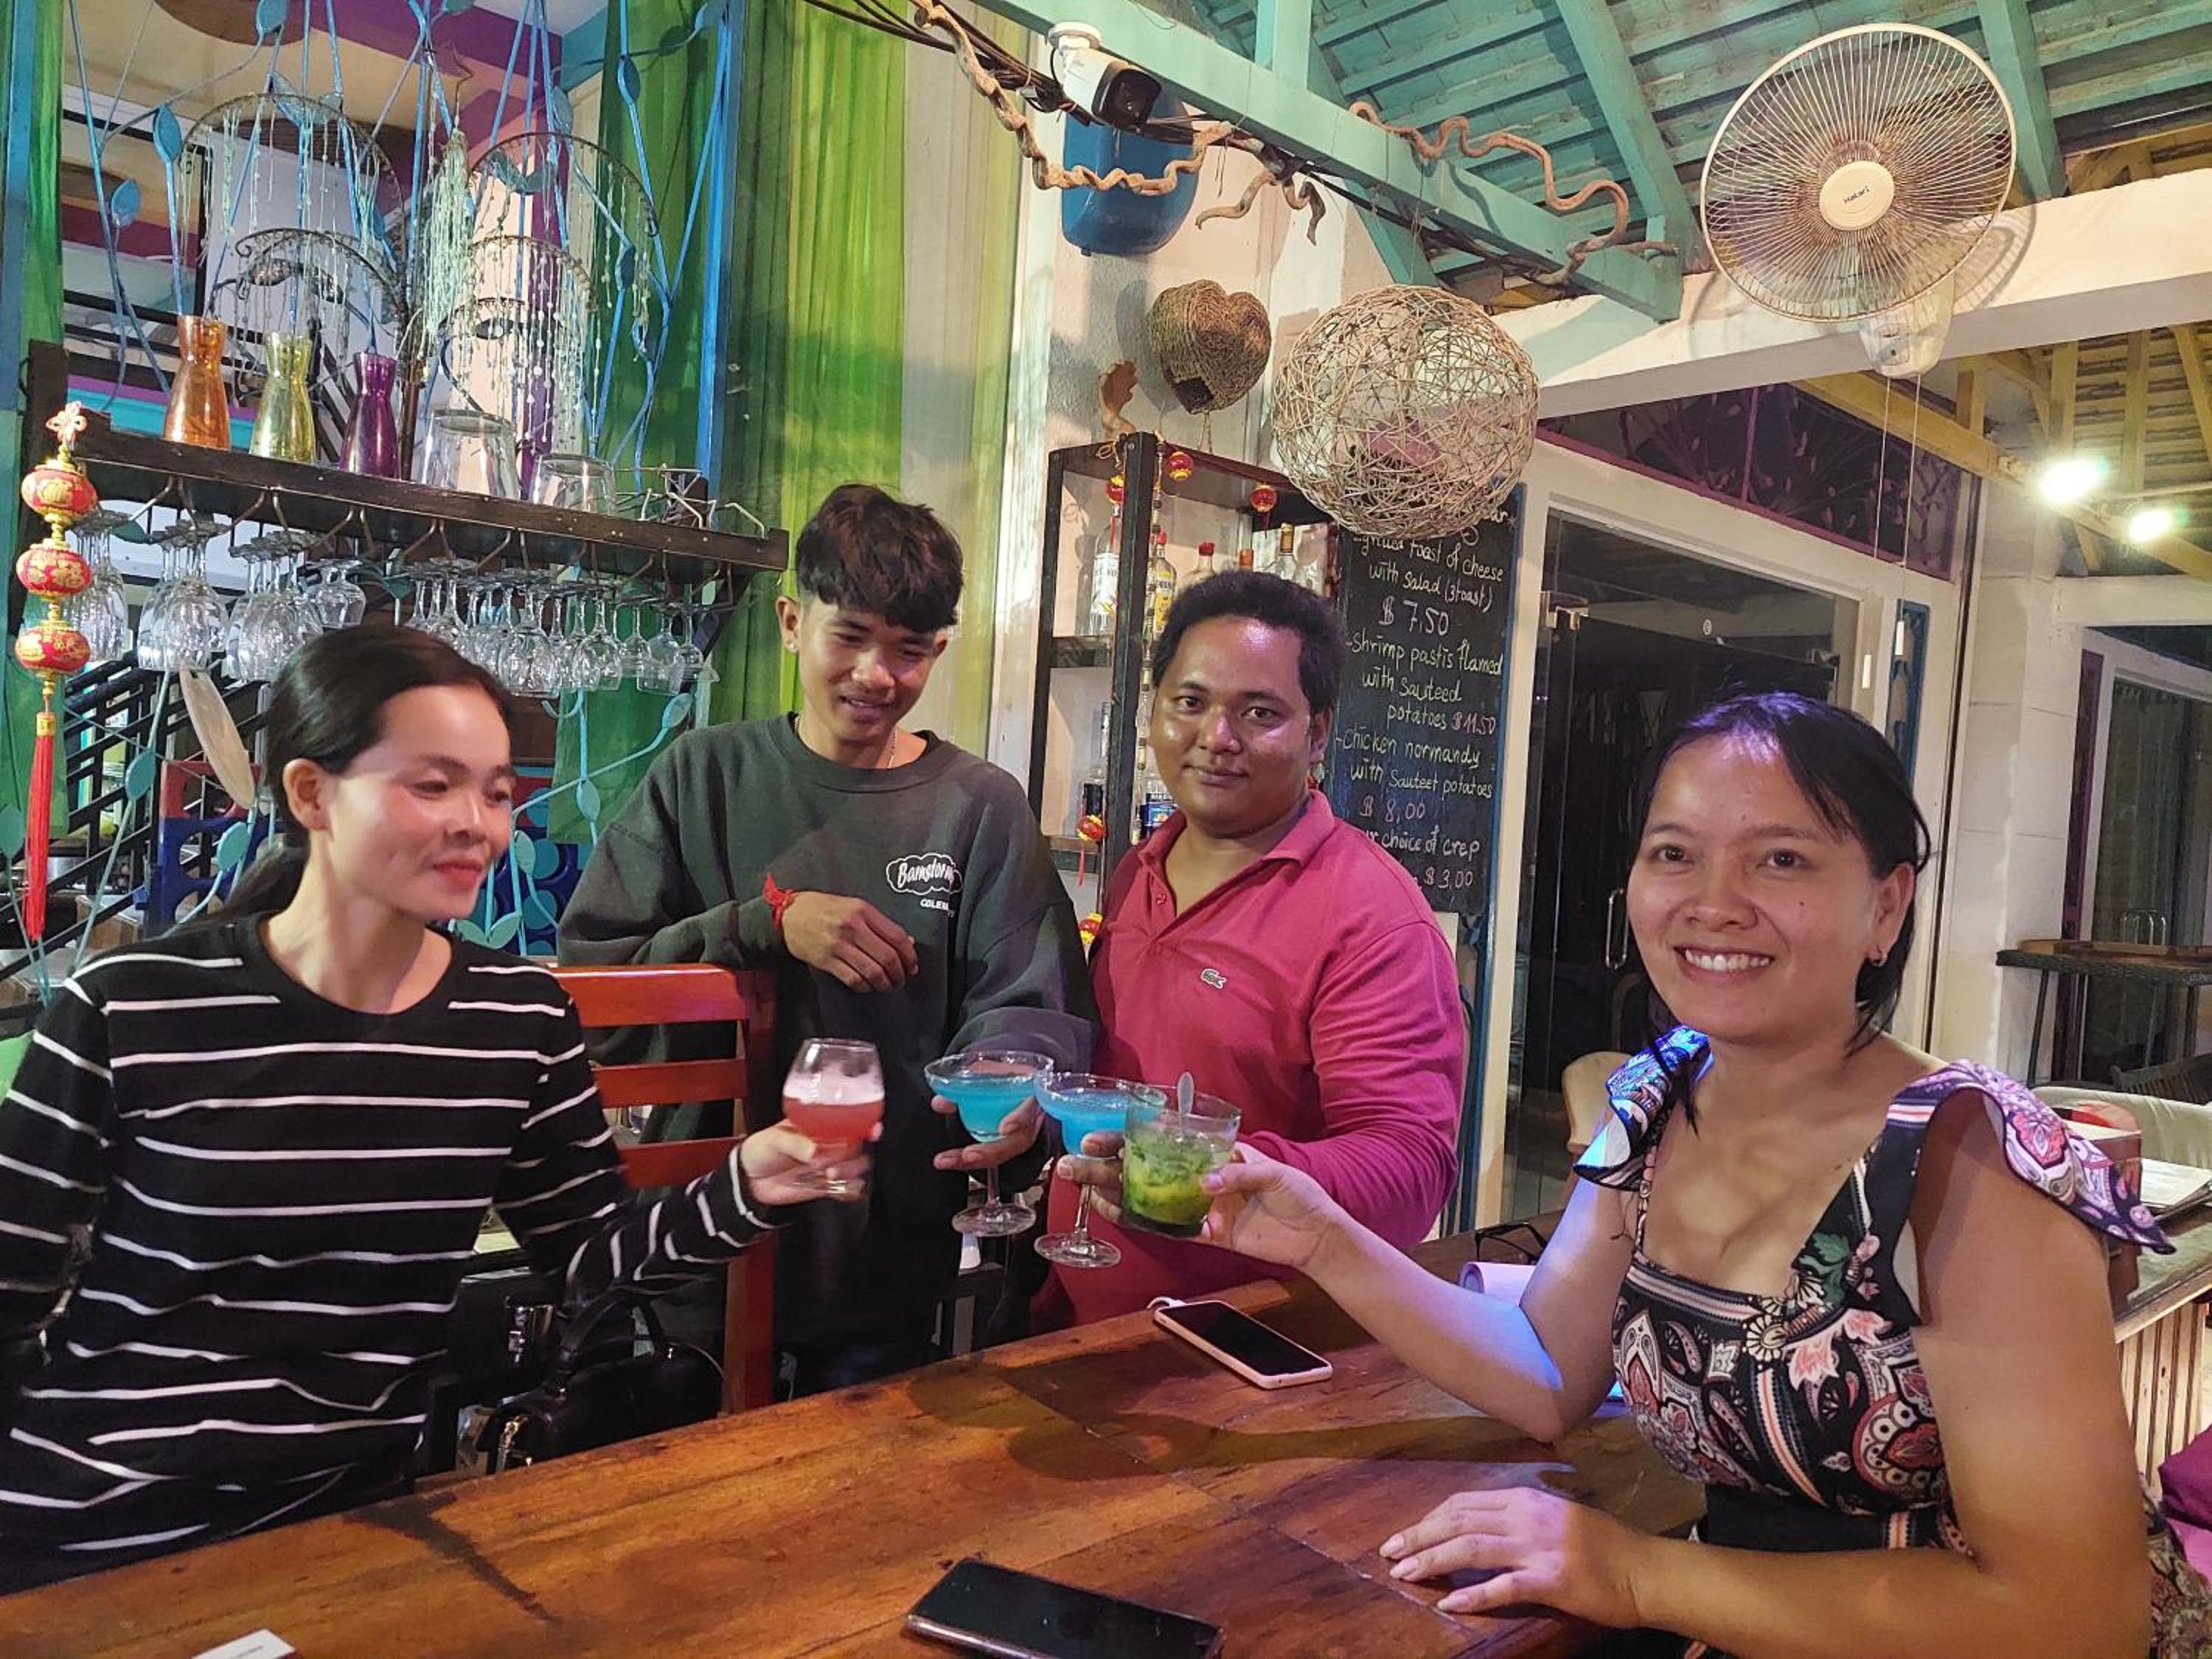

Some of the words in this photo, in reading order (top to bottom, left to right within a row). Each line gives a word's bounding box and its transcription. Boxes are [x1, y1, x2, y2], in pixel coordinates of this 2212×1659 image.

[1369, 559, 1399, 585] with
[1446, 542, 1461, 572] of
[1462, 554, 1504, 582] cheese
[1379, 596, 1395, 626] $
[1411, 644, 1454, 672] pastis
[1363, 665, 1394, 692] with
[1387, 700, 1447, 731] potatoes
[1405, 744, 1481, 769] normandy
[1350, 758, 1384, 785] with
[1441, 775, 1493, 801] potatoes
[1381, 829, 1422, 852] choice
[1425, 824, 1440, 855] of
[1442, 838, 1481, 862] crep
[1423, 866, 1436, 886] $
